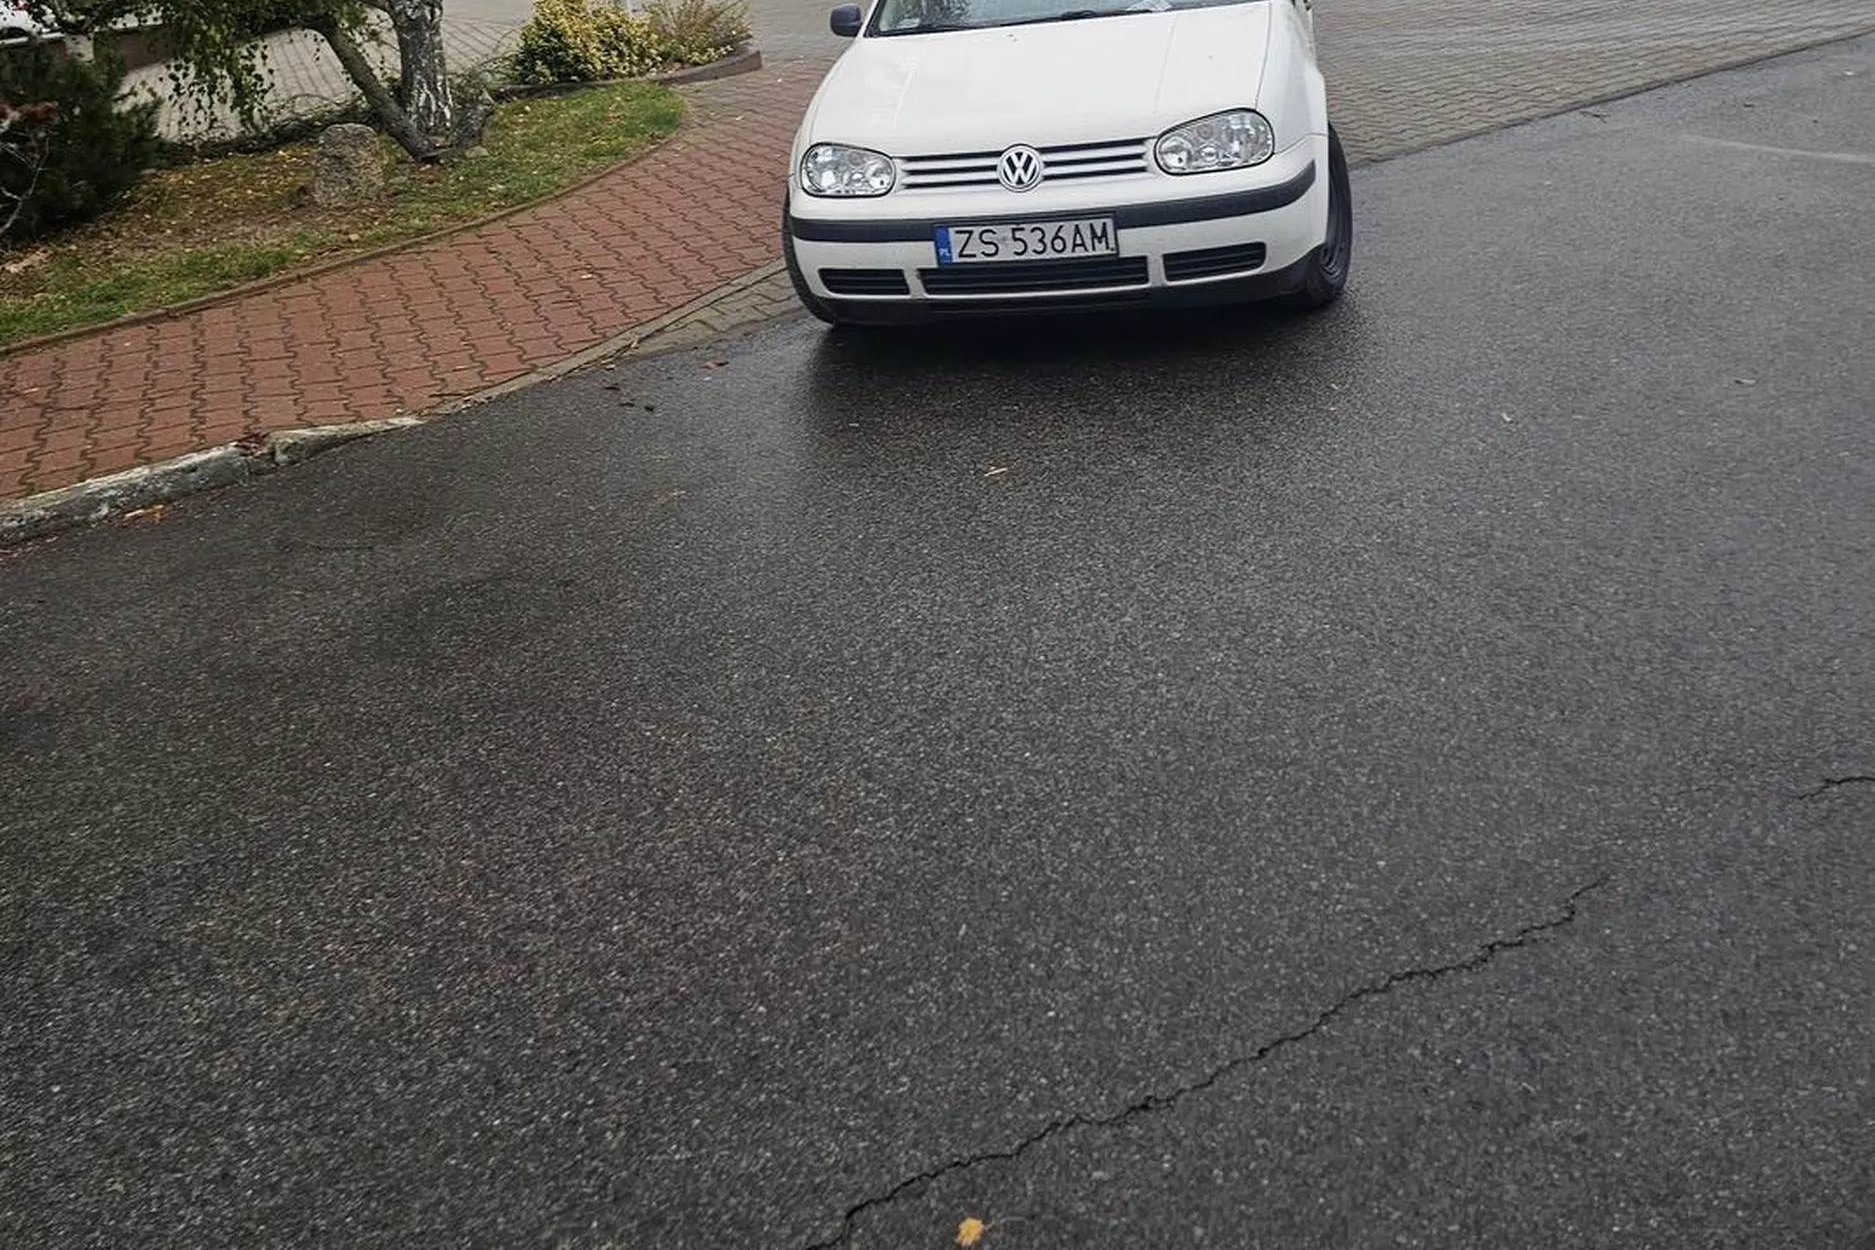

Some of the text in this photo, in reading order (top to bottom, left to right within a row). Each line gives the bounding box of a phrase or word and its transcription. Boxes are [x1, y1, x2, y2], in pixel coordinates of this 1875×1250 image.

[1001, 148, 1038, 188] VW
[954, 229, 1000, 258] ZS
[1011, 222, 1111, 256] 536AM
